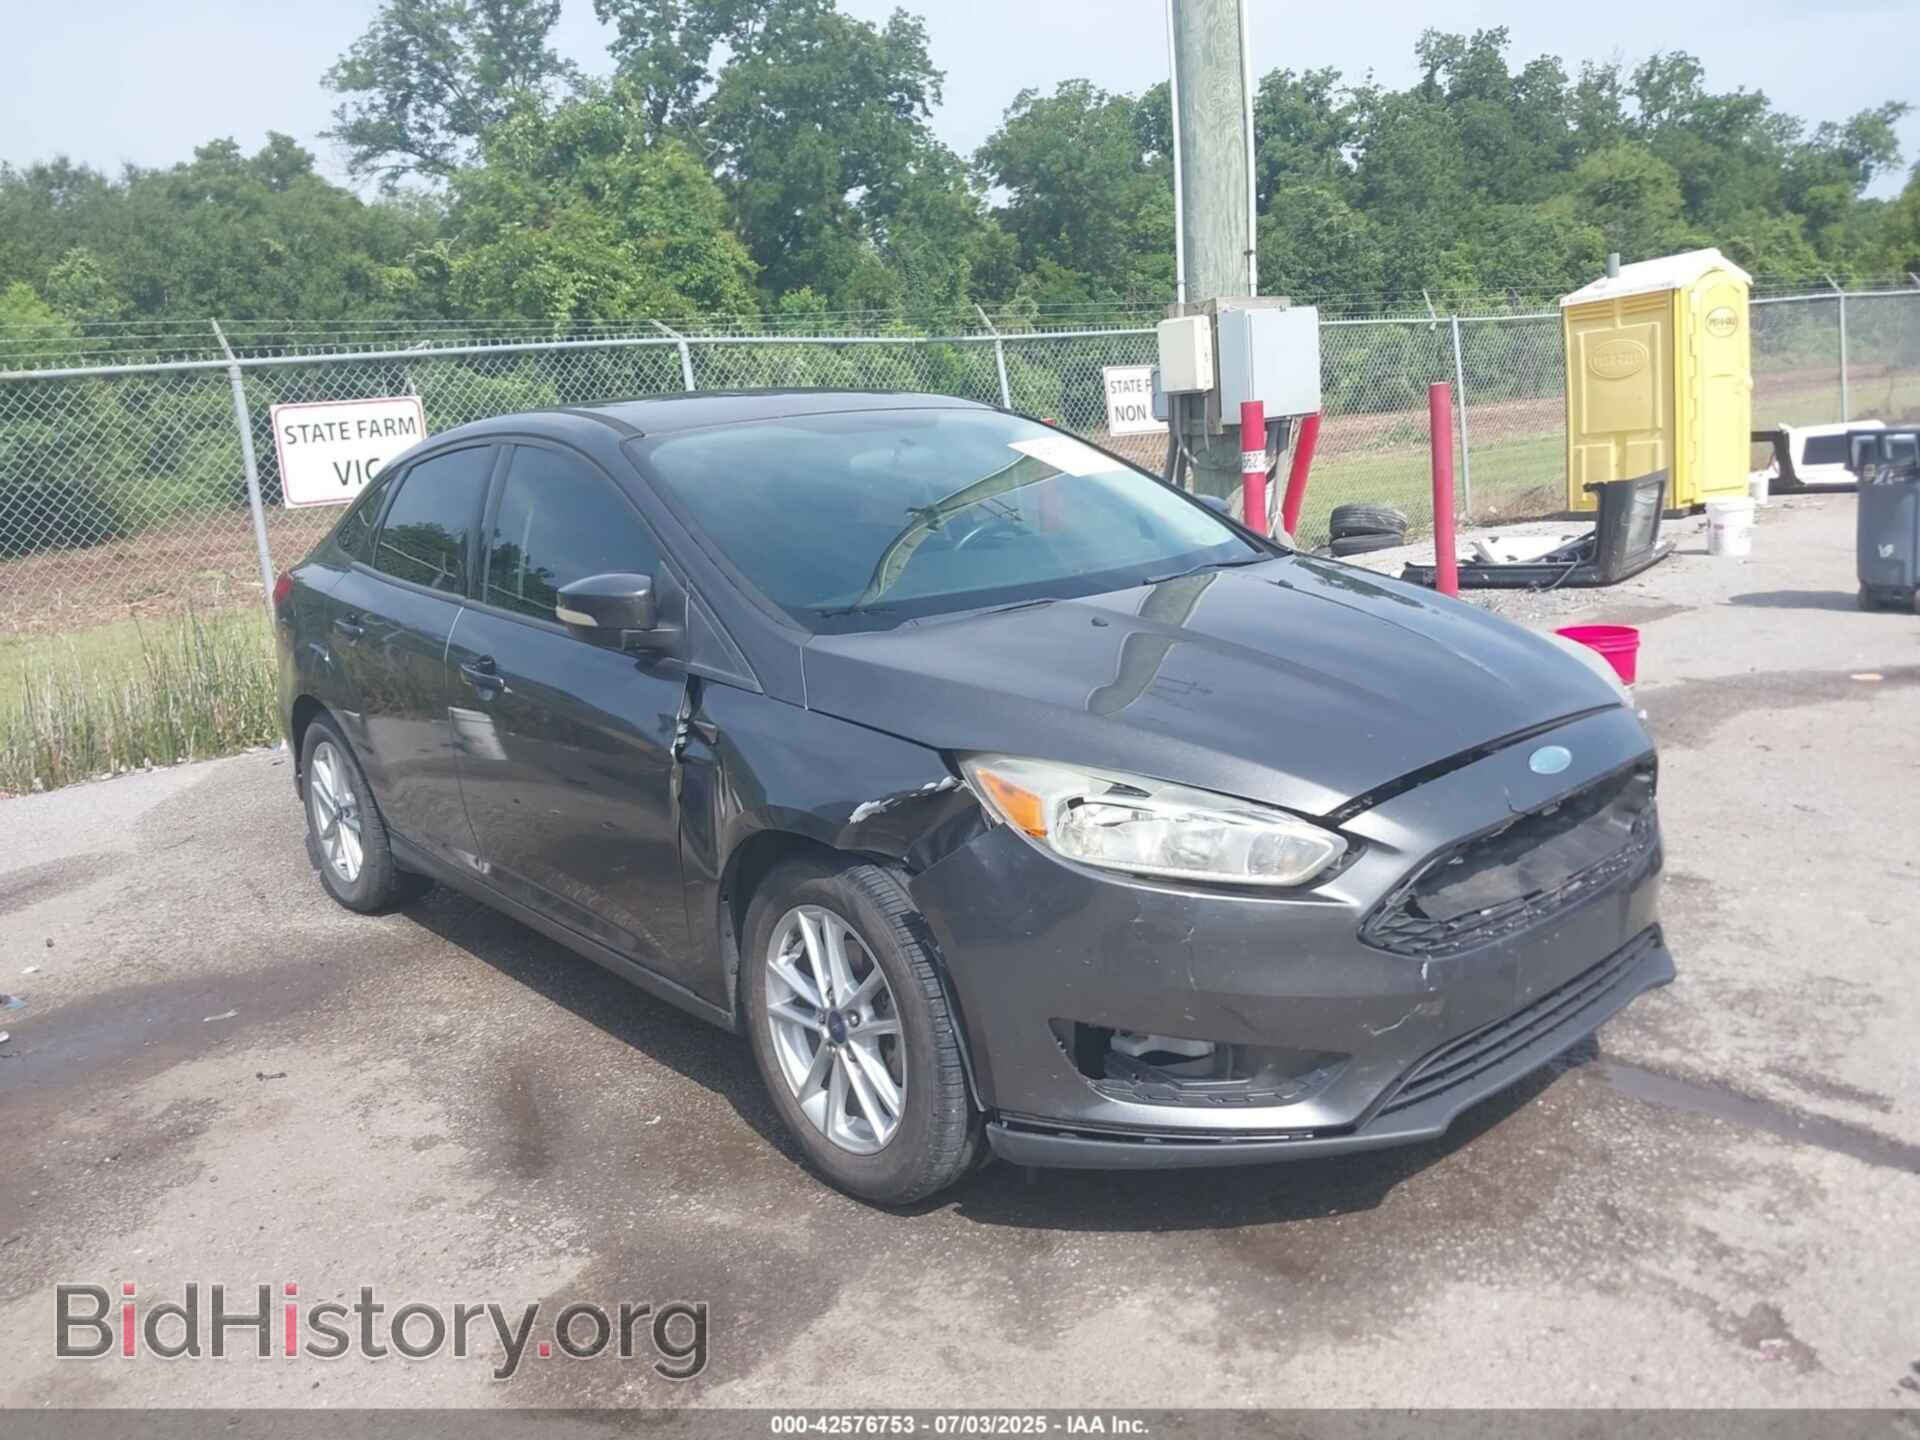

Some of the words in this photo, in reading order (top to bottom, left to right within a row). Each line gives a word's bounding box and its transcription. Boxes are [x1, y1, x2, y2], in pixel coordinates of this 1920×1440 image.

[1110, 379, 1143, 393] STATE
[1114, 404, 1147, 421] NON
[284, 421, 351, 445] STATE
[356, 416, 417, 439] FARM
